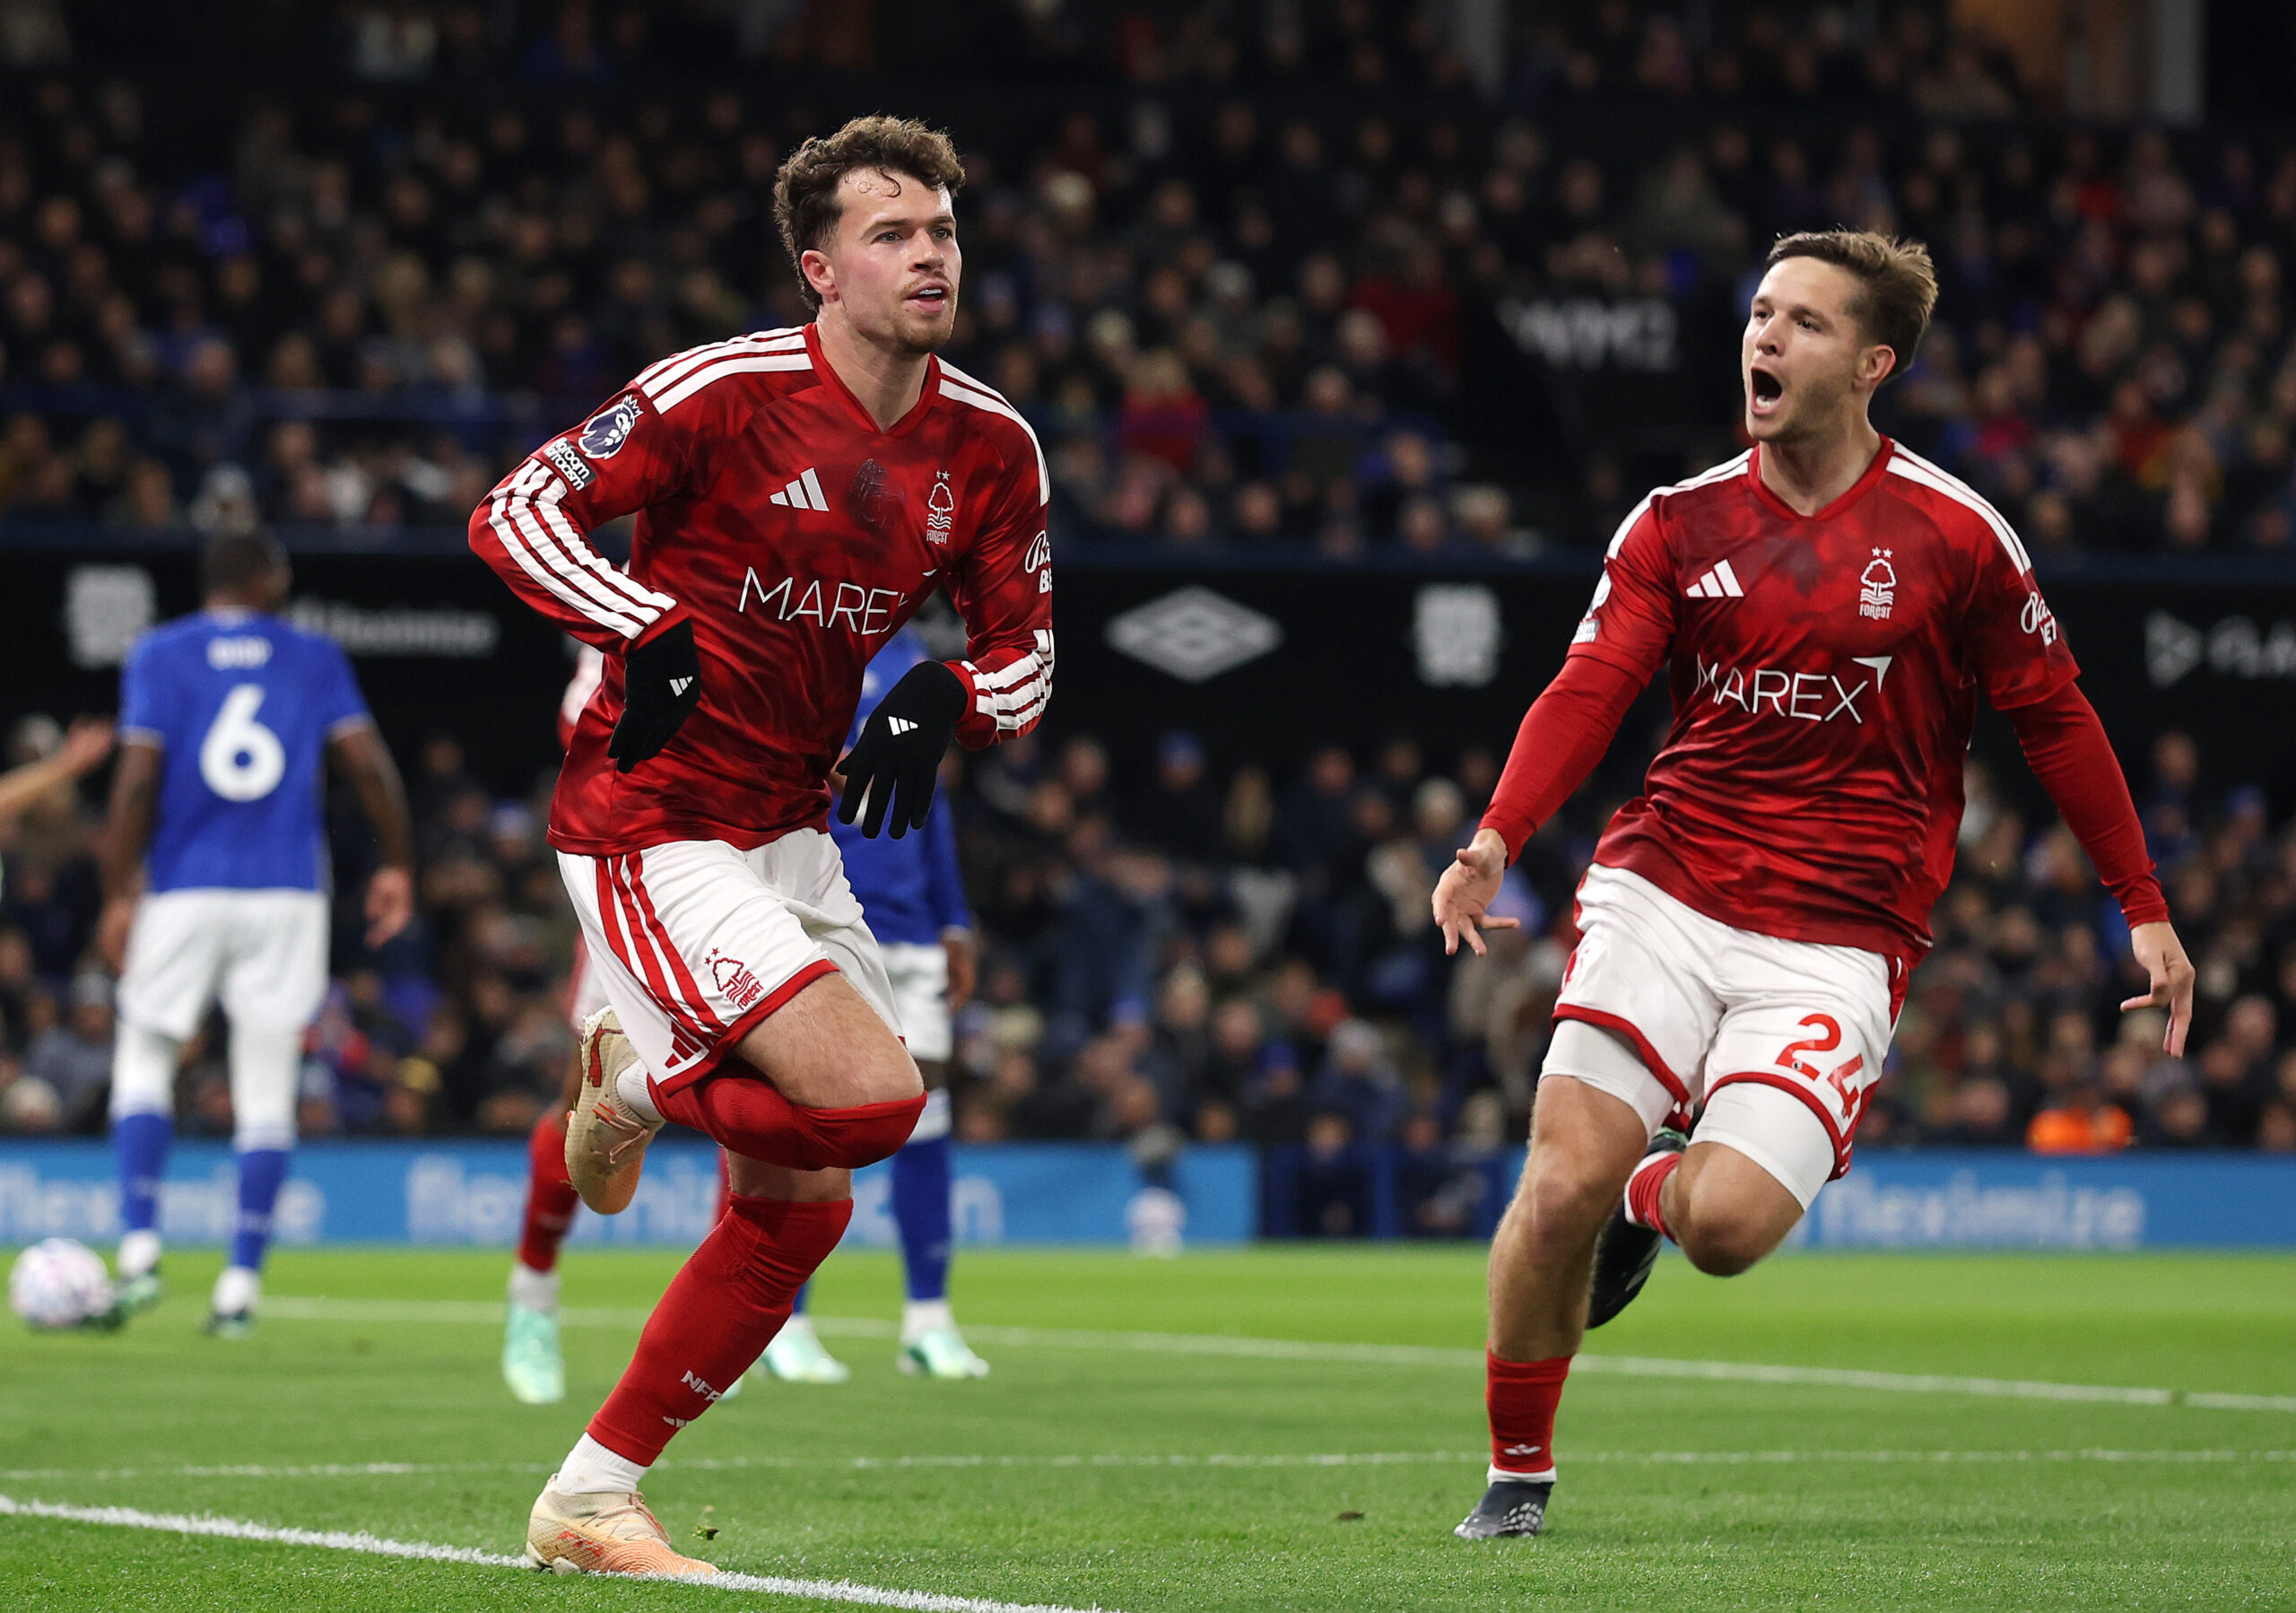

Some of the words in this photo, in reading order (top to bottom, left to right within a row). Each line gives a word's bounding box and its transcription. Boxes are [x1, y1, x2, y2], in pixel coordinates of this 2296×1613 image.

[1859, 603, 1892, 621] FOREST
[1693, 652, 1868, 724] MAREX
[200, 683, 286, 803] 6
[1775, 1013, 1864, 1119] 24
